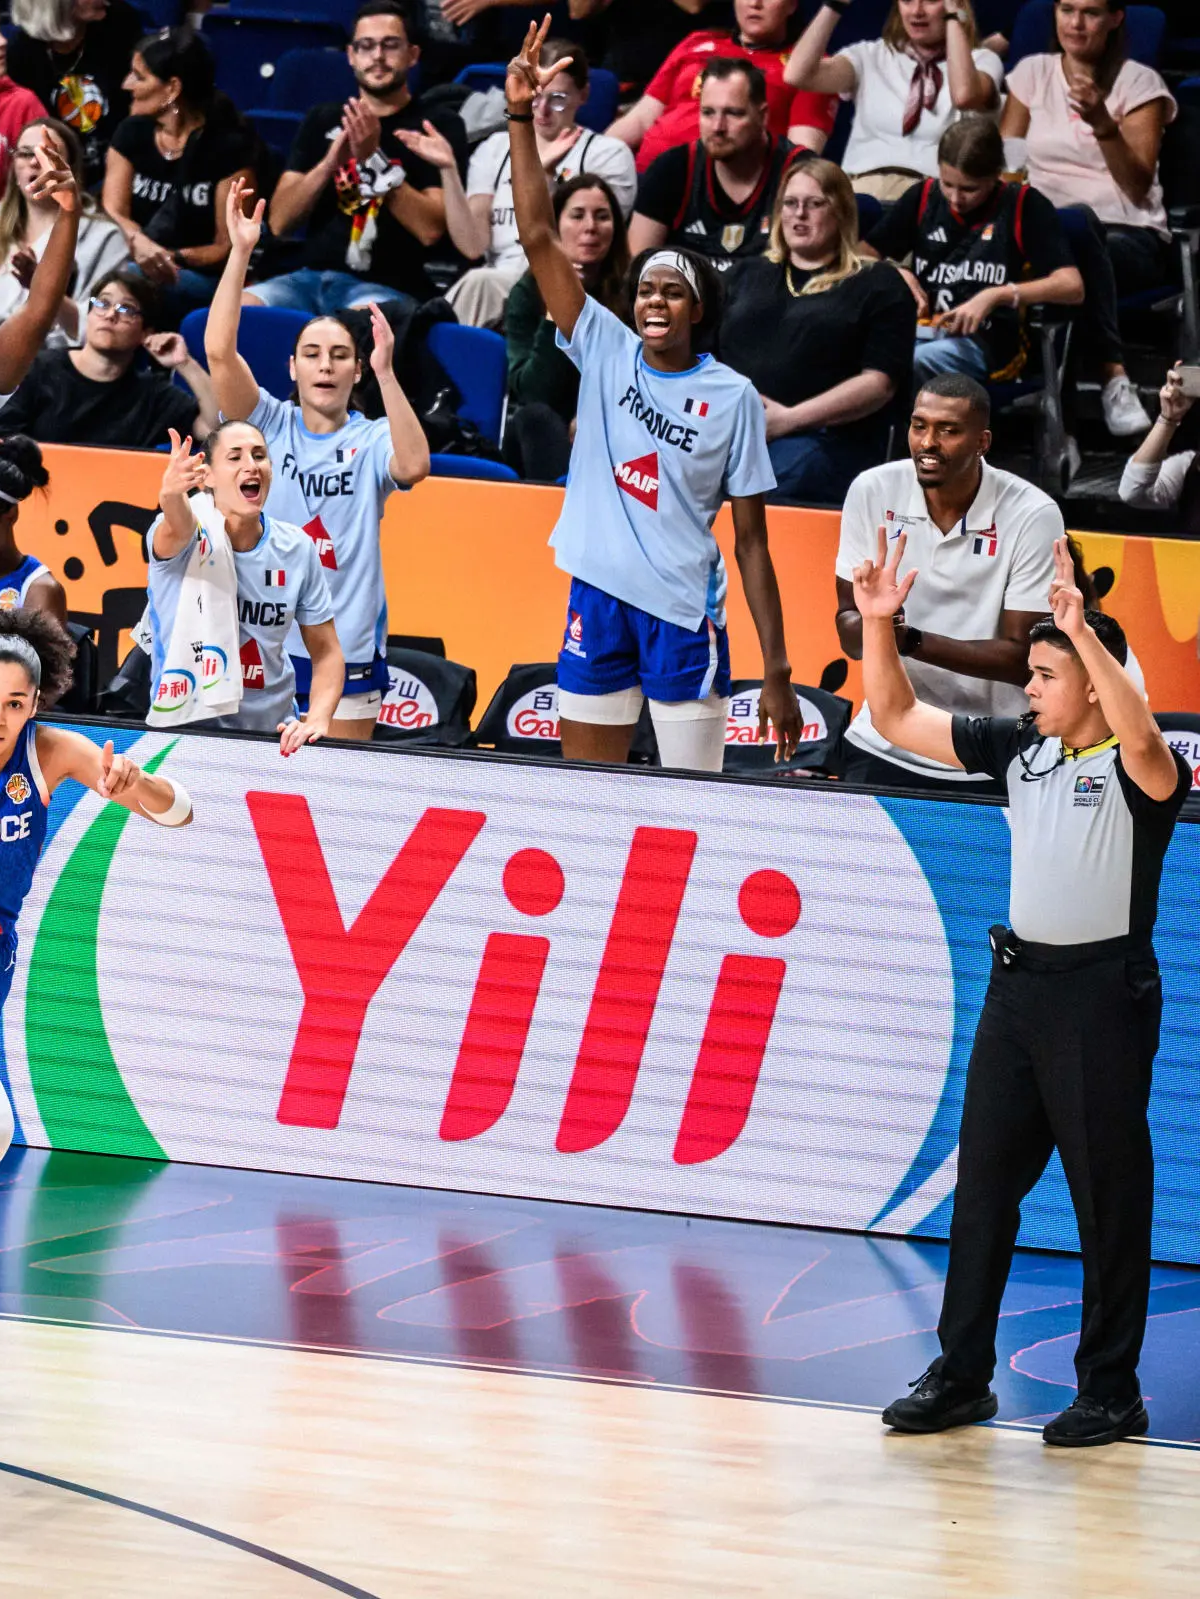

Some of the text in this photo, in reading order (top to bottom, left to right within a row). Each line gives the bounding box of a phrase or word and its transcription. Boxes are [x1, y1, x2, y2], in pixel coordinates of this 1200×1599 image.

[618, 384, 699, 453] FRANCE
[614, 461, 660, 493] MAIF
[245, 790, 802, 1166] Yili
